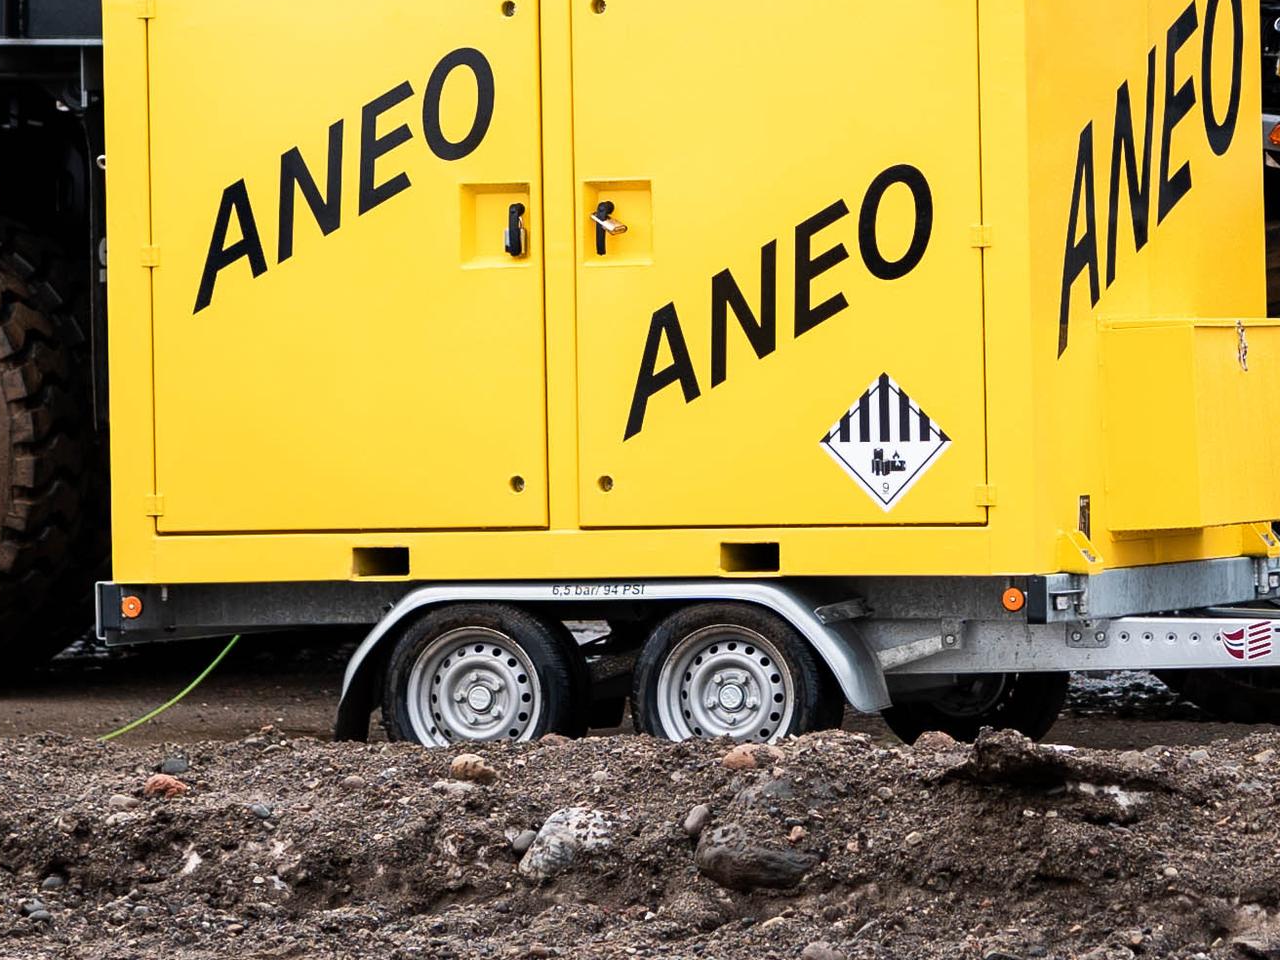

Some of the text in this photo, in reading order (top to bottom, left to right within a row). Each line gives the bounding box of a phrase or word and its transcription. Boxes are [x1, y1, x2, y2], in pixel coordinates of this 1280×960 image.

[192, 47, 495, 315] ANEO
[623, 164, 933, 442] ANEO
[882, 482, 890, 493] 9
[552, 584, 572, 596] 6,5
[603, 584, 619, 595] 94
[622, 583, 646, 595] PSI
